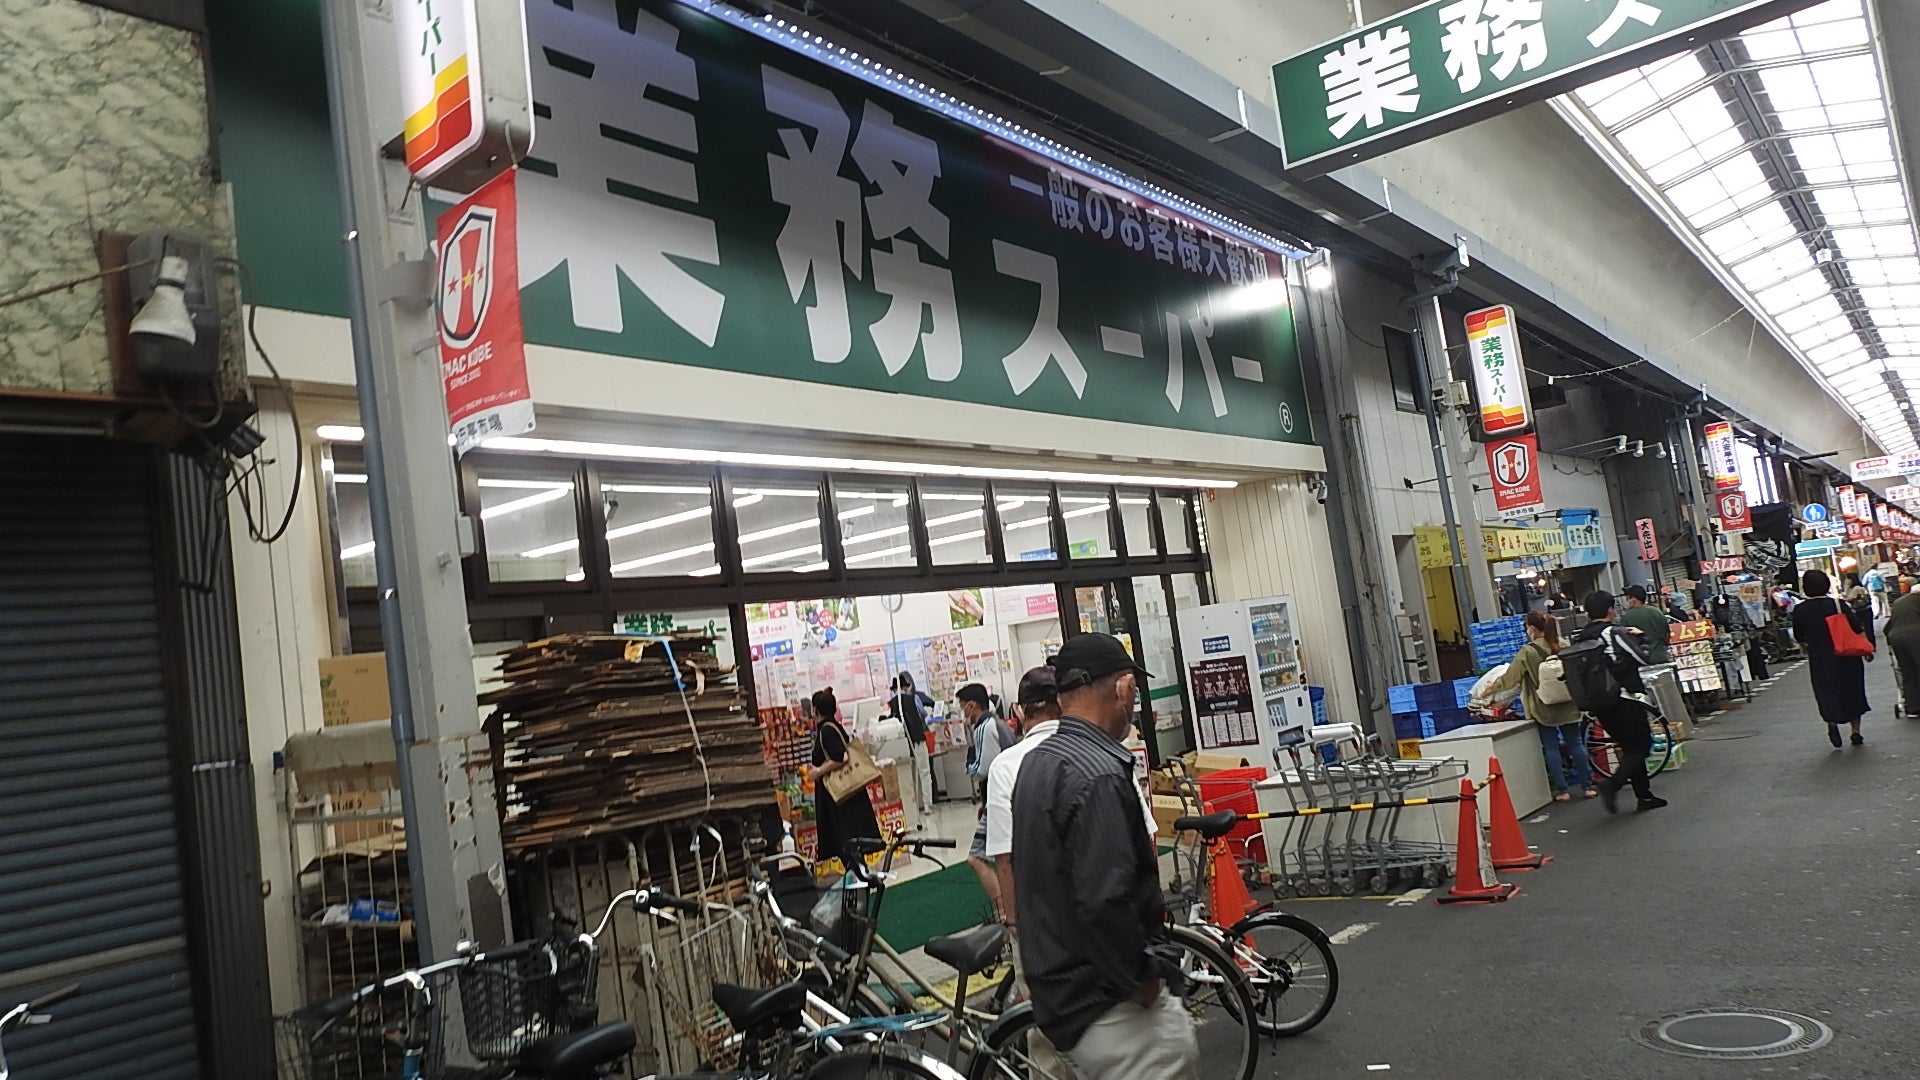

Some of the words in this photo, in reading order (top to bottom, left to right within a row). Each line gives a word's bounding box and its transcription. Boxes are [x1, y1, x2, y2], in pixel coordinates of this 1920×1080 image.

[467, 341, 493, 370] KOBE
[1480, 335, 1506, 403] 業務スーパー
[1640, 521, 1655, 560] 大売出し
[1704, 558, 1740, 572] SALE
[1669, 620, 1712, 640] ムチ
